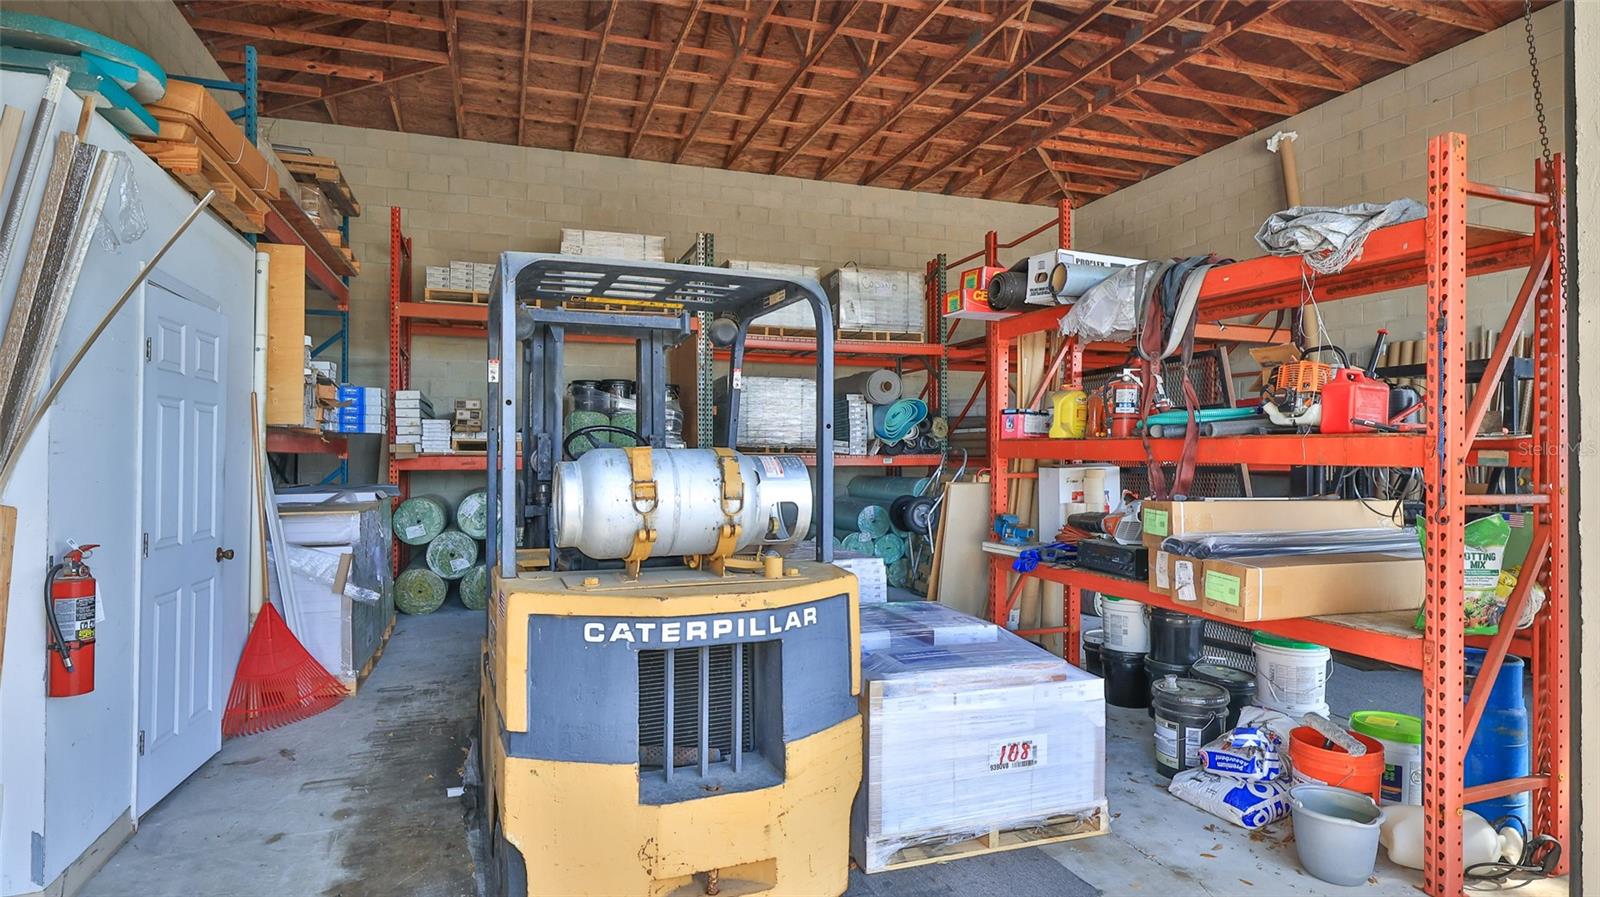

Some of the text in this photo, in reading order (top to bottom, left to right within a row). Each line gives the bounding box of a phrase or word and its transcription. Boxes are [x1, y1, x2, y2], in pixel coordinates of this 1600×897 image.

[1463, 552, 1496, 561] OTTING
[1470, 561, 1486, 569] MIX
[583, 606, 818, 643] CATERPILLAR
[999, 742, 1031, 765] 108
[1214, 754, 1249, 768] Absorbent
[1216, 761, 1244, 771] Premium
